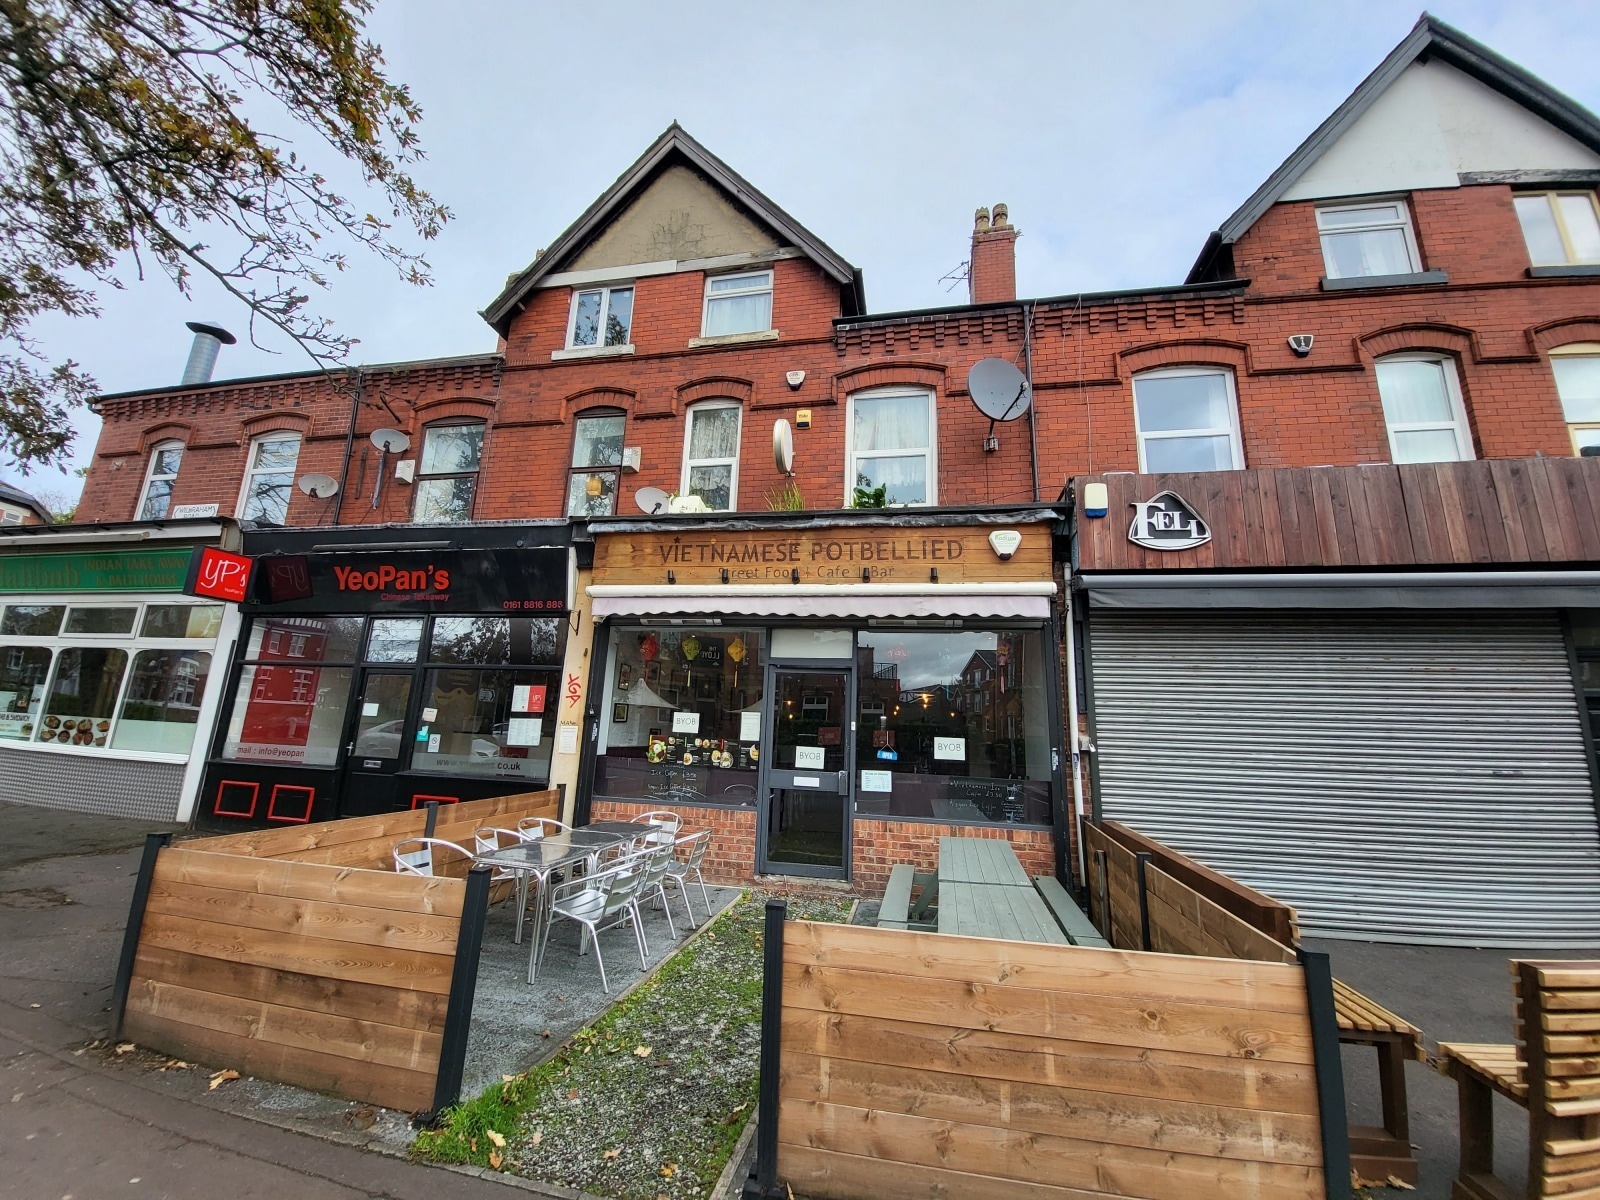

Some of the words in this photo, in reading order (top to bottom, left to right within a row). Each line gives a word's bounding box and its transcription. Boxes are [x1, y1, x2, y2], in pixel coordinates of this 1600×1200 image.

[1130, 502, 1210, 539] FELL
[659, 537, 801, 563] VIETNAMESE
[811, 539, 963, 561] POTBELLIED
[84, 558, 123, 570] INDIAN
[126, 557, 154, 570] TAKE
[158, 556, 187, 569] AWAY
[200, 558, 246, 588] YP's
[333, 564, 450, 591] YeoPan's
[718, 567, 760, 579] reet
[817, 565, 850, 578] Cafe
[871, 565, 895, 578] Bar
[142, 573, 178, 586] HOUSE
[380, 592, 411, 601] Chinese
[413, 592, 450, 602] Takeaway
[503, 600, 521, 609] 0161
[523, 600, 544, 609] 8816
[676, 717, 697, 726] BYOB
[937, 742, 962, 752] BYOB
[799, 751, 821, 760] BYOB
